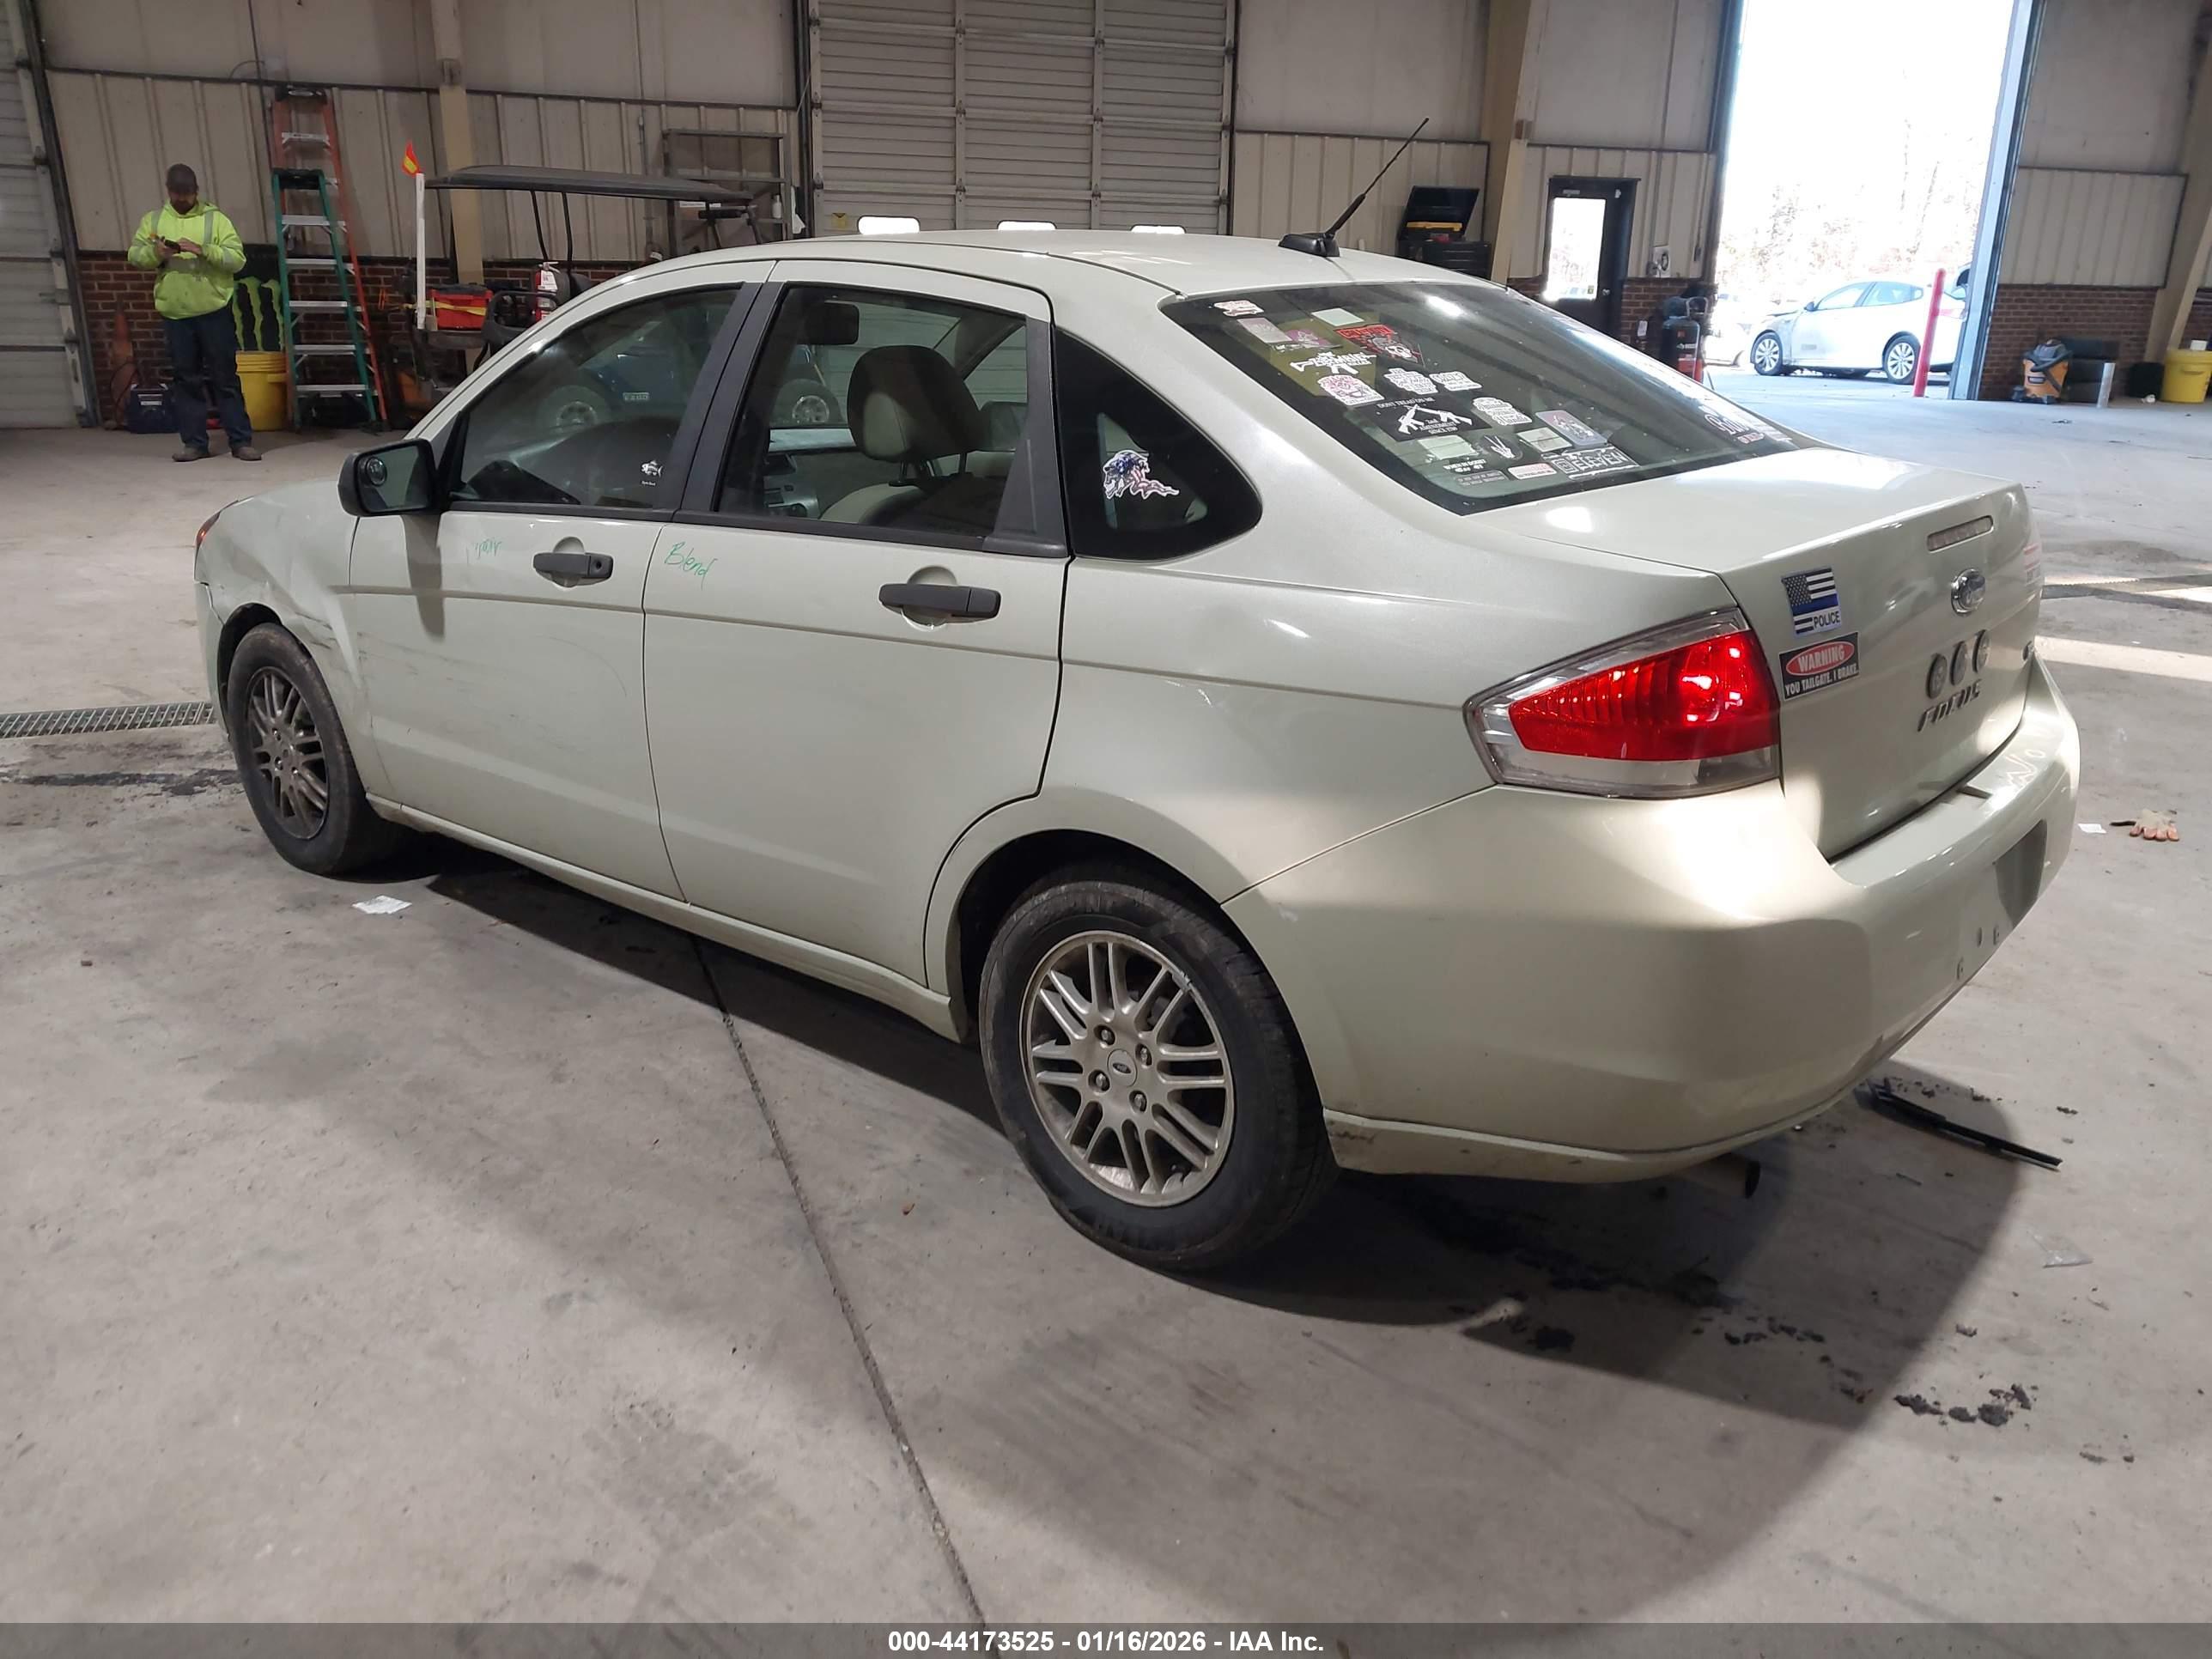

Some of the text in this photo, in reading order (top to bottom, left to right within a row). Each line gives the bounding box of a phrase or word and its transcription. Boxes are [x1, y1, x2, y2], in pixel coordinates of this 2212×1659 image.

[664, 541, 718, 590] Blend
[1814, 611, 1840, 629] POLICE
[1797, 645, 1845, 672] WARNING
[1785, 681, 1801, 696] YOU
